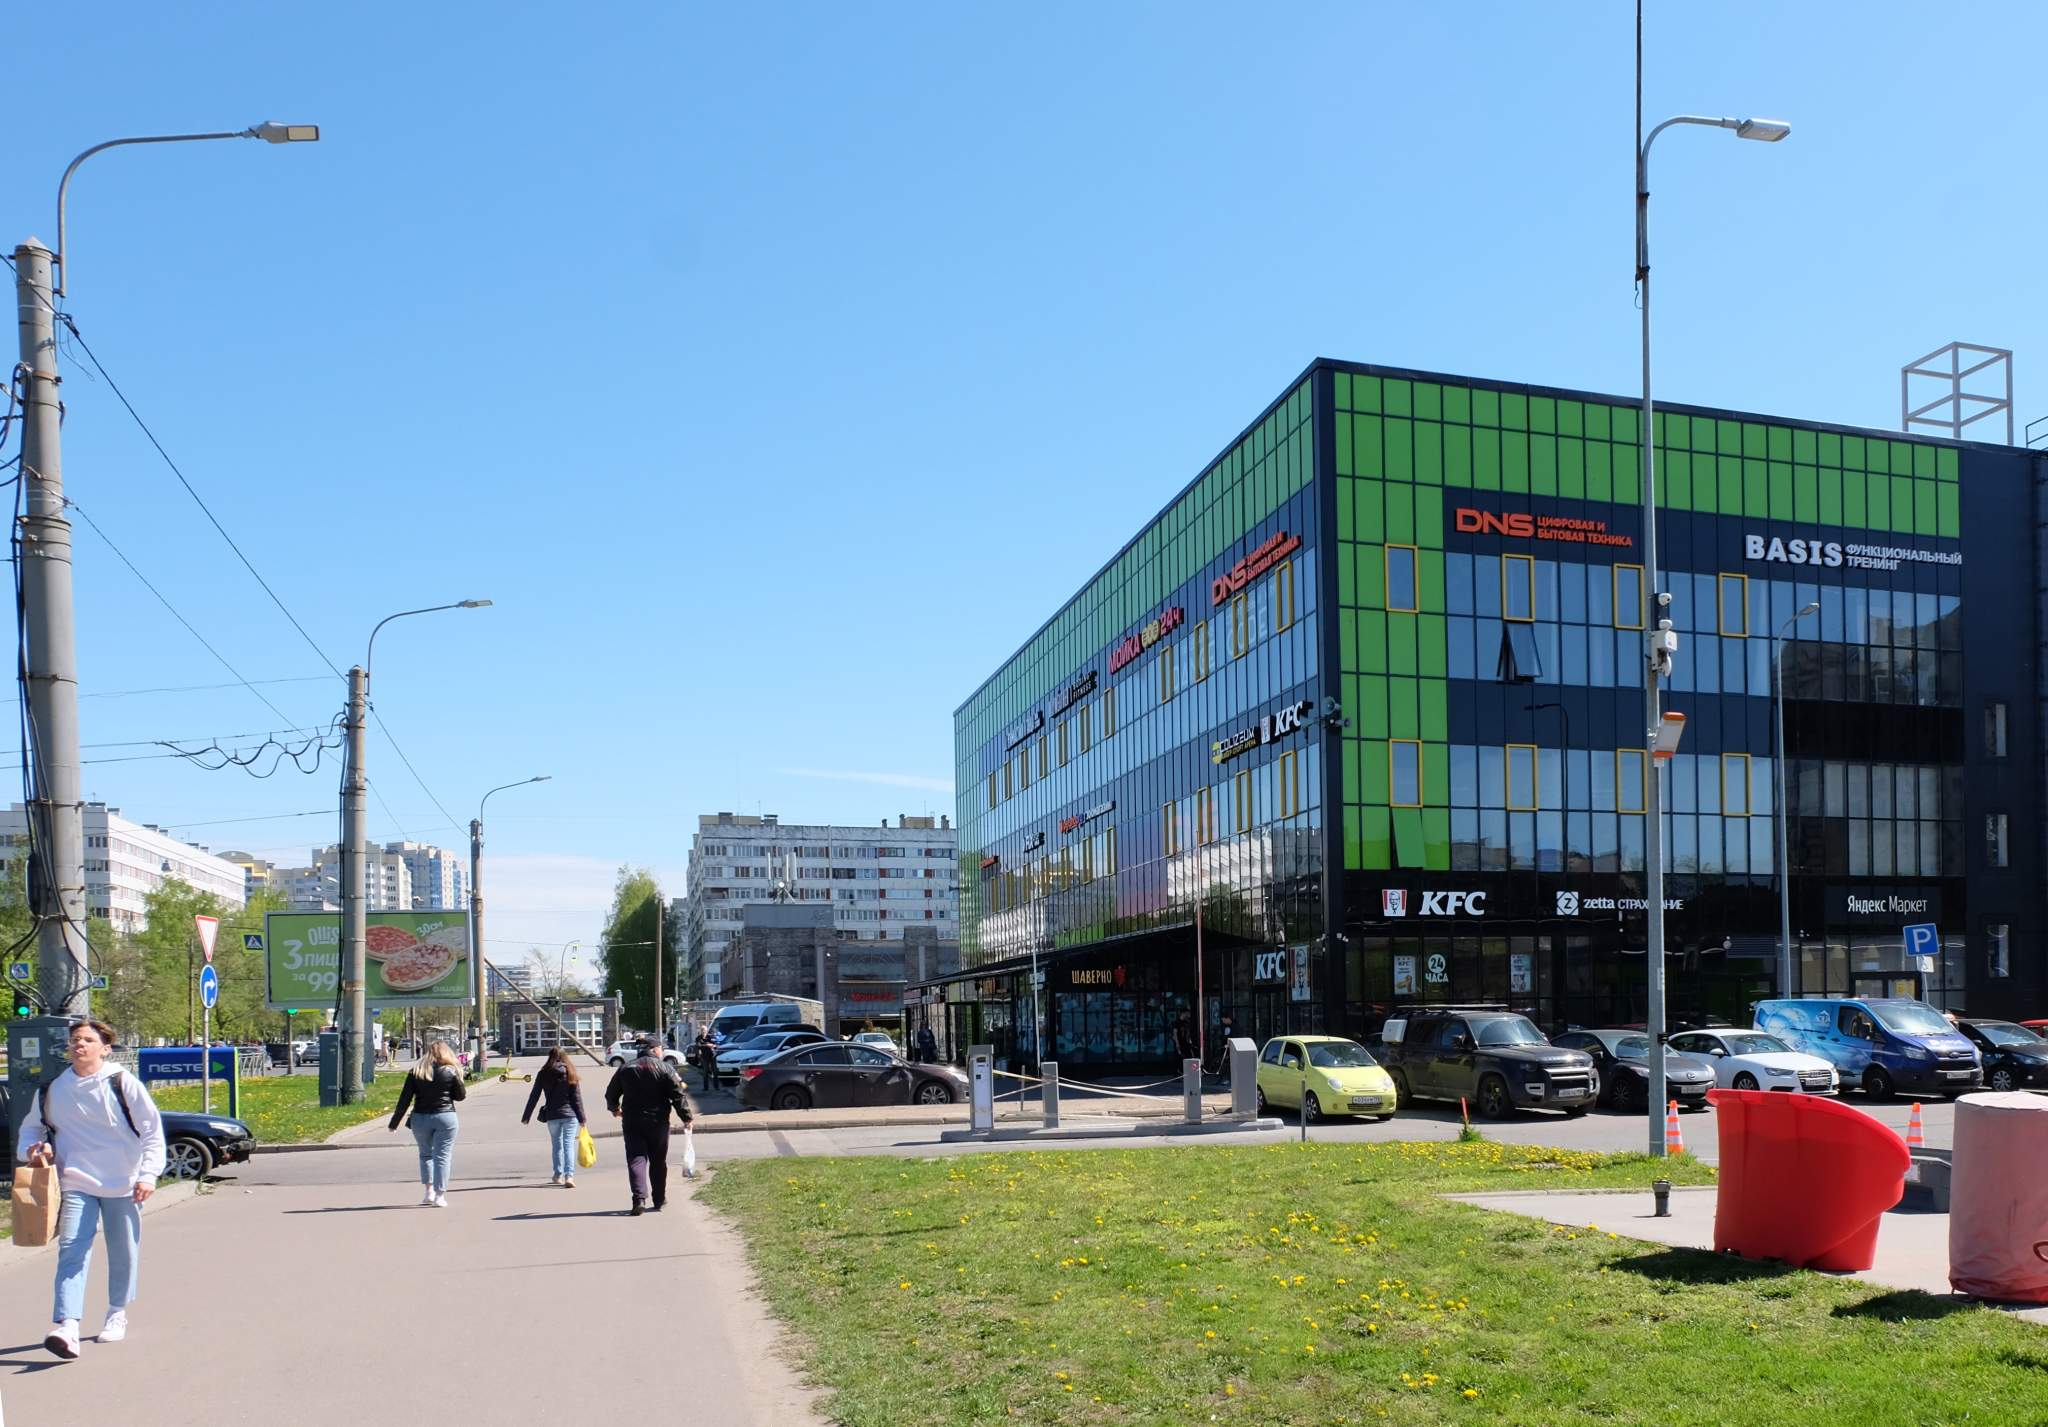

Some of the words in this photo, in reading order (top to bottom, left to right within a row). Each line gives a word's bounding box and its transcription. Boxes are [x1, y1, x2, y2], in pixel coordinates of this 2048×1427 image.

[1456, 508, 1535, 537] DNS
[1537, 516, 1595, 531] ЦИФРОВАЯ
[1597, 522, 1605, 531] И
[1537, 529, 1585, 541] БЫТОВАЯ
[1587, 533, 1632, 546] ТЕХНИКА
[1745, 535, 1843, 567] BASIS
[1845, 544, 1962, 565] ФУНКЦИОНАЛЬНЫЙ
[1846, 555, 1900, 570] ТРЕНИНГ
[1212, 557, 1247, 605] DNS
[1109, 634, 1140, 674] МОЙКА
[1275, 701, 1303, 736] KFC
[1419, 891, 1486, 915] KFC
[1584, 898, 1615, 909] zetta
[1618, 899, 1684, 909] СТРАХНИЕ
[1847, 895, 1887, 914] Яндекс
[1889, 896, 1928, 915] Маркет
[1912, 928, 1931, 953] P
[282, 939, 304, 970] 3
[305, 952, 340, 968] ПИЦ
[1255, 951, 1286, 979] KFC
[1431, 956, 1444, 969] 24
[307, 971, 340, 992] 99
[1071, 970, 1112, 984] ШАВЕРНО
[1425, 973, 1449, 983] ЧАСА
